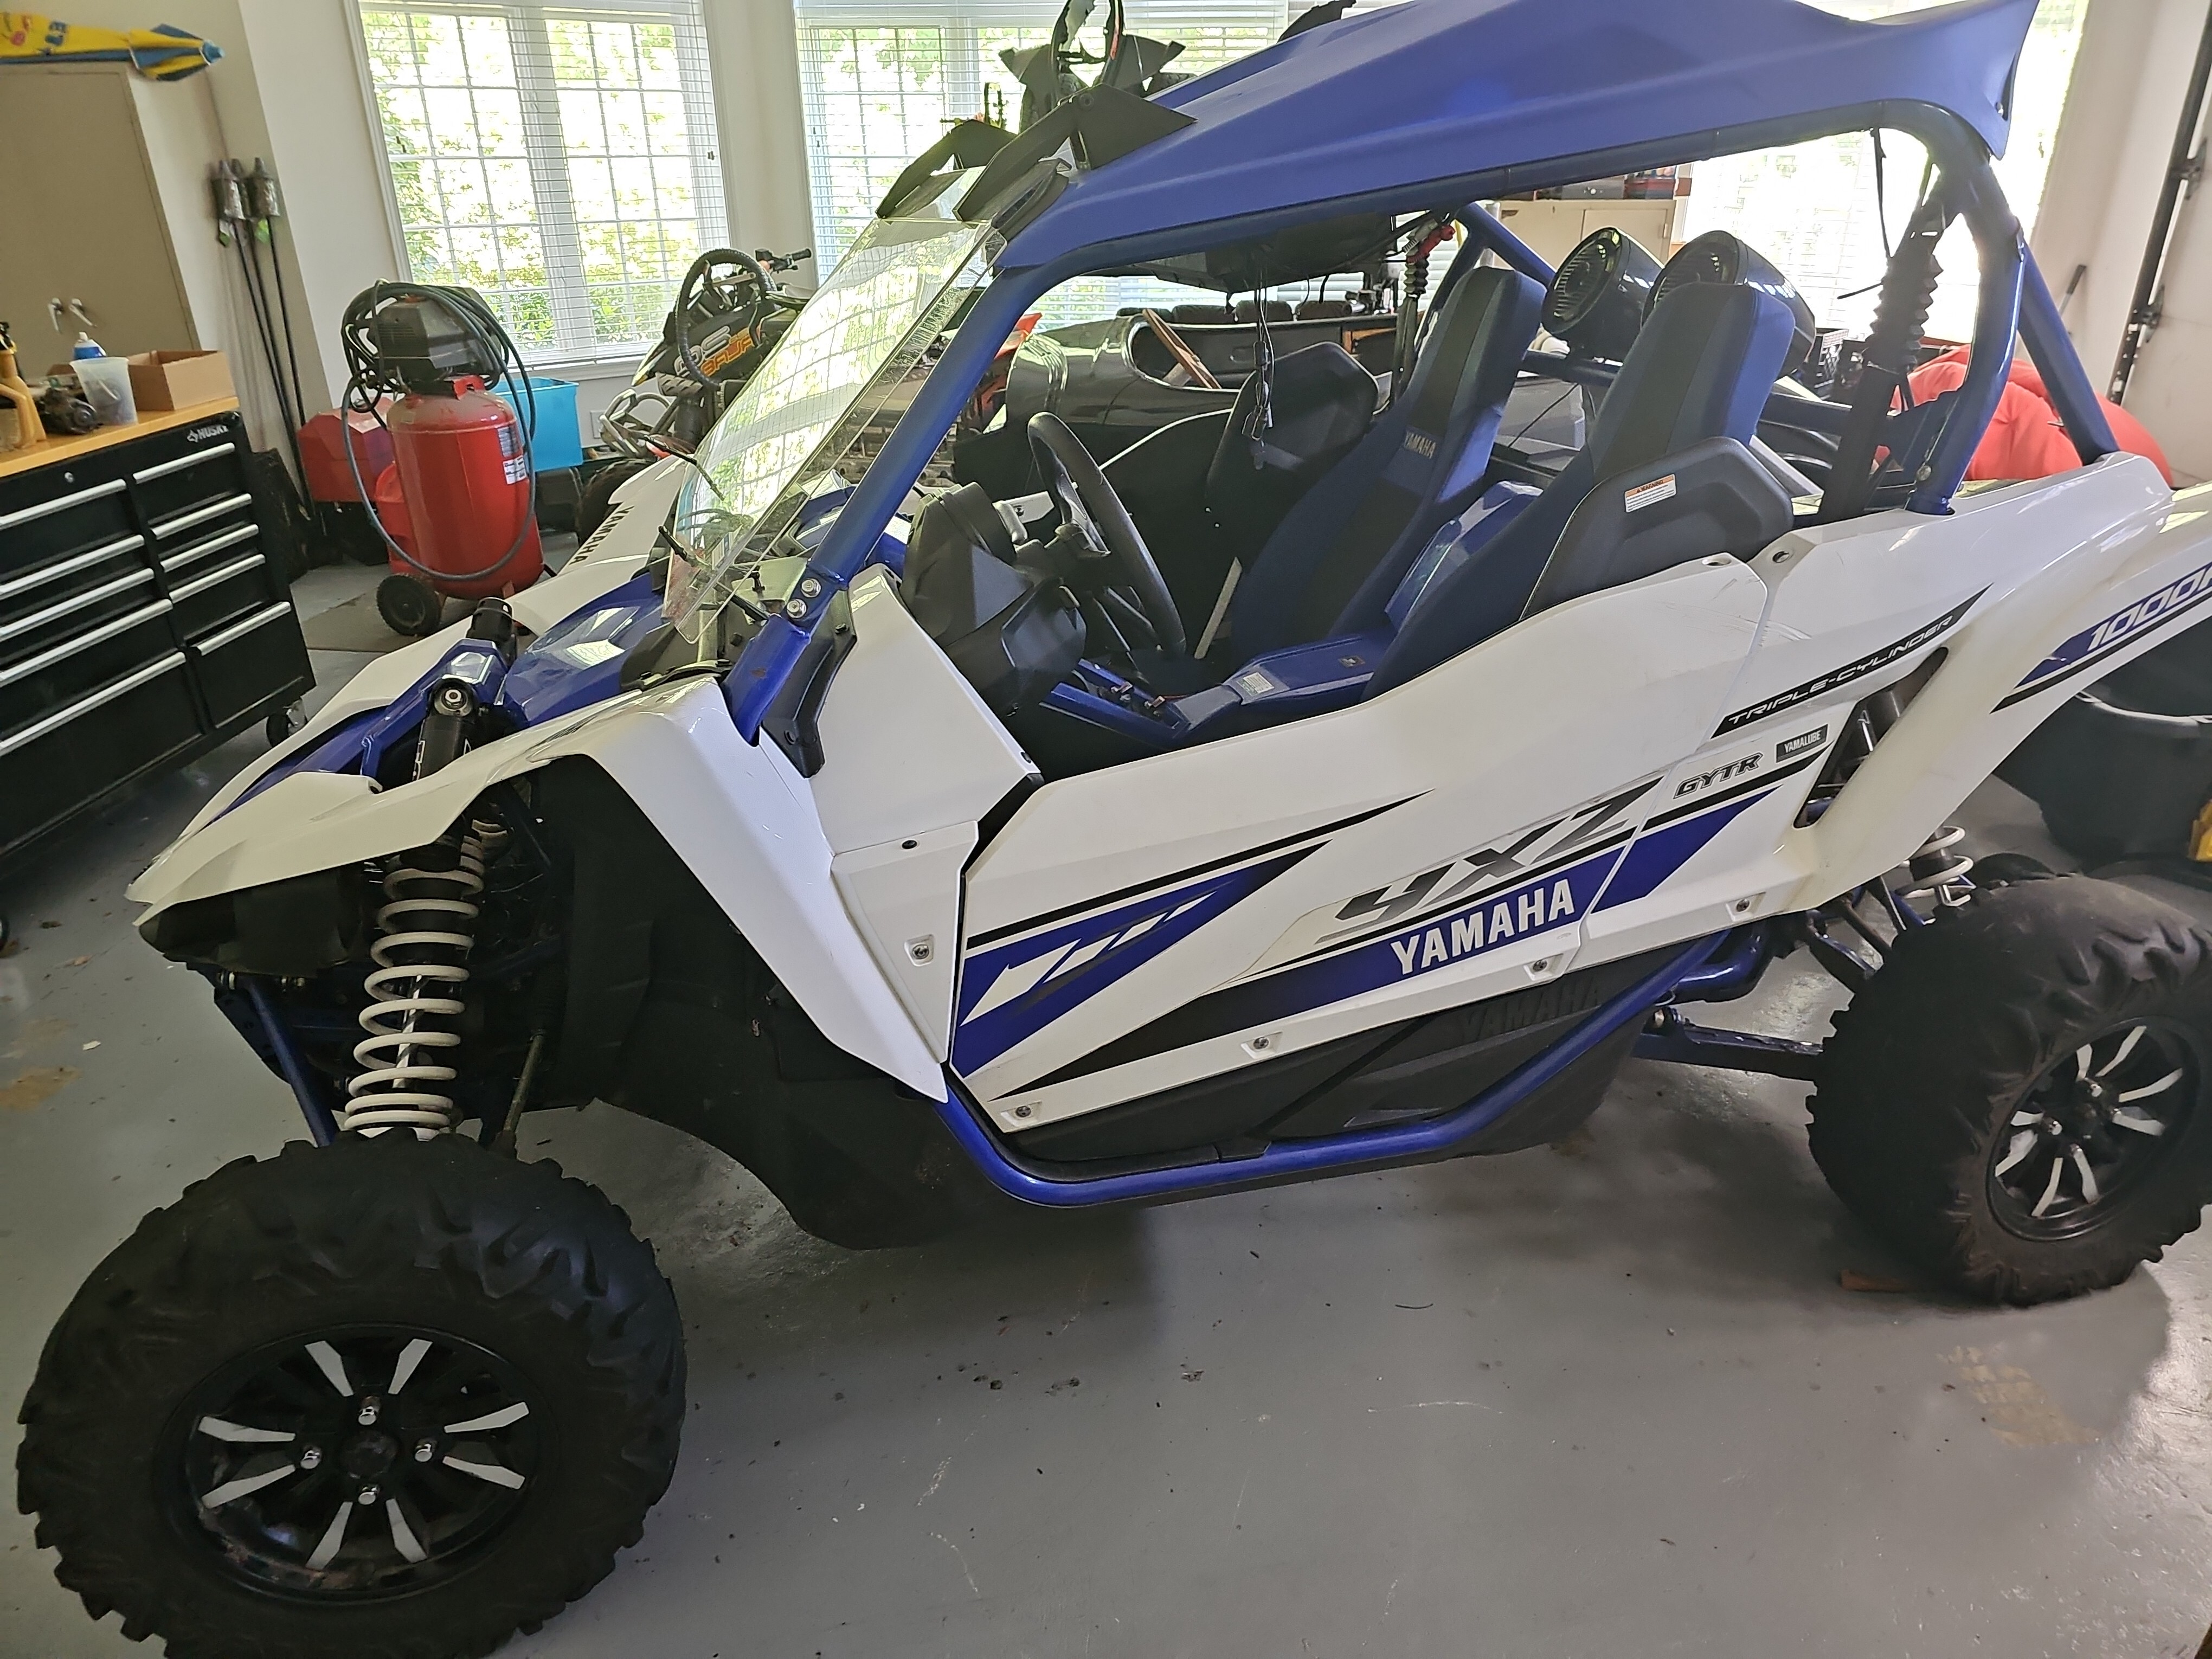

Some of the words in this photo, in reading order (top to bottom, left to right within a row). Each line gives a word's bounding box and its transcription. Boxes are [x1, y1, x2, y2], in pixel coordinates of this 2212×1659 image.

[197, 425, 229, 440] HUSKY
[1404, 432, 1436, 459] YAMAHA
[569, 505, 635, 565] YAMAHA
[1728, 615, 1953, 724] TRIPLE-CYLINDER
[1784, 730, 1822, 753] YAMALUBE
[1674, 752, 1763, 799] GYTR
[1314, 776, 1664, 944] YXZ
[1390, 878, 1574, 975] YAMAHA
